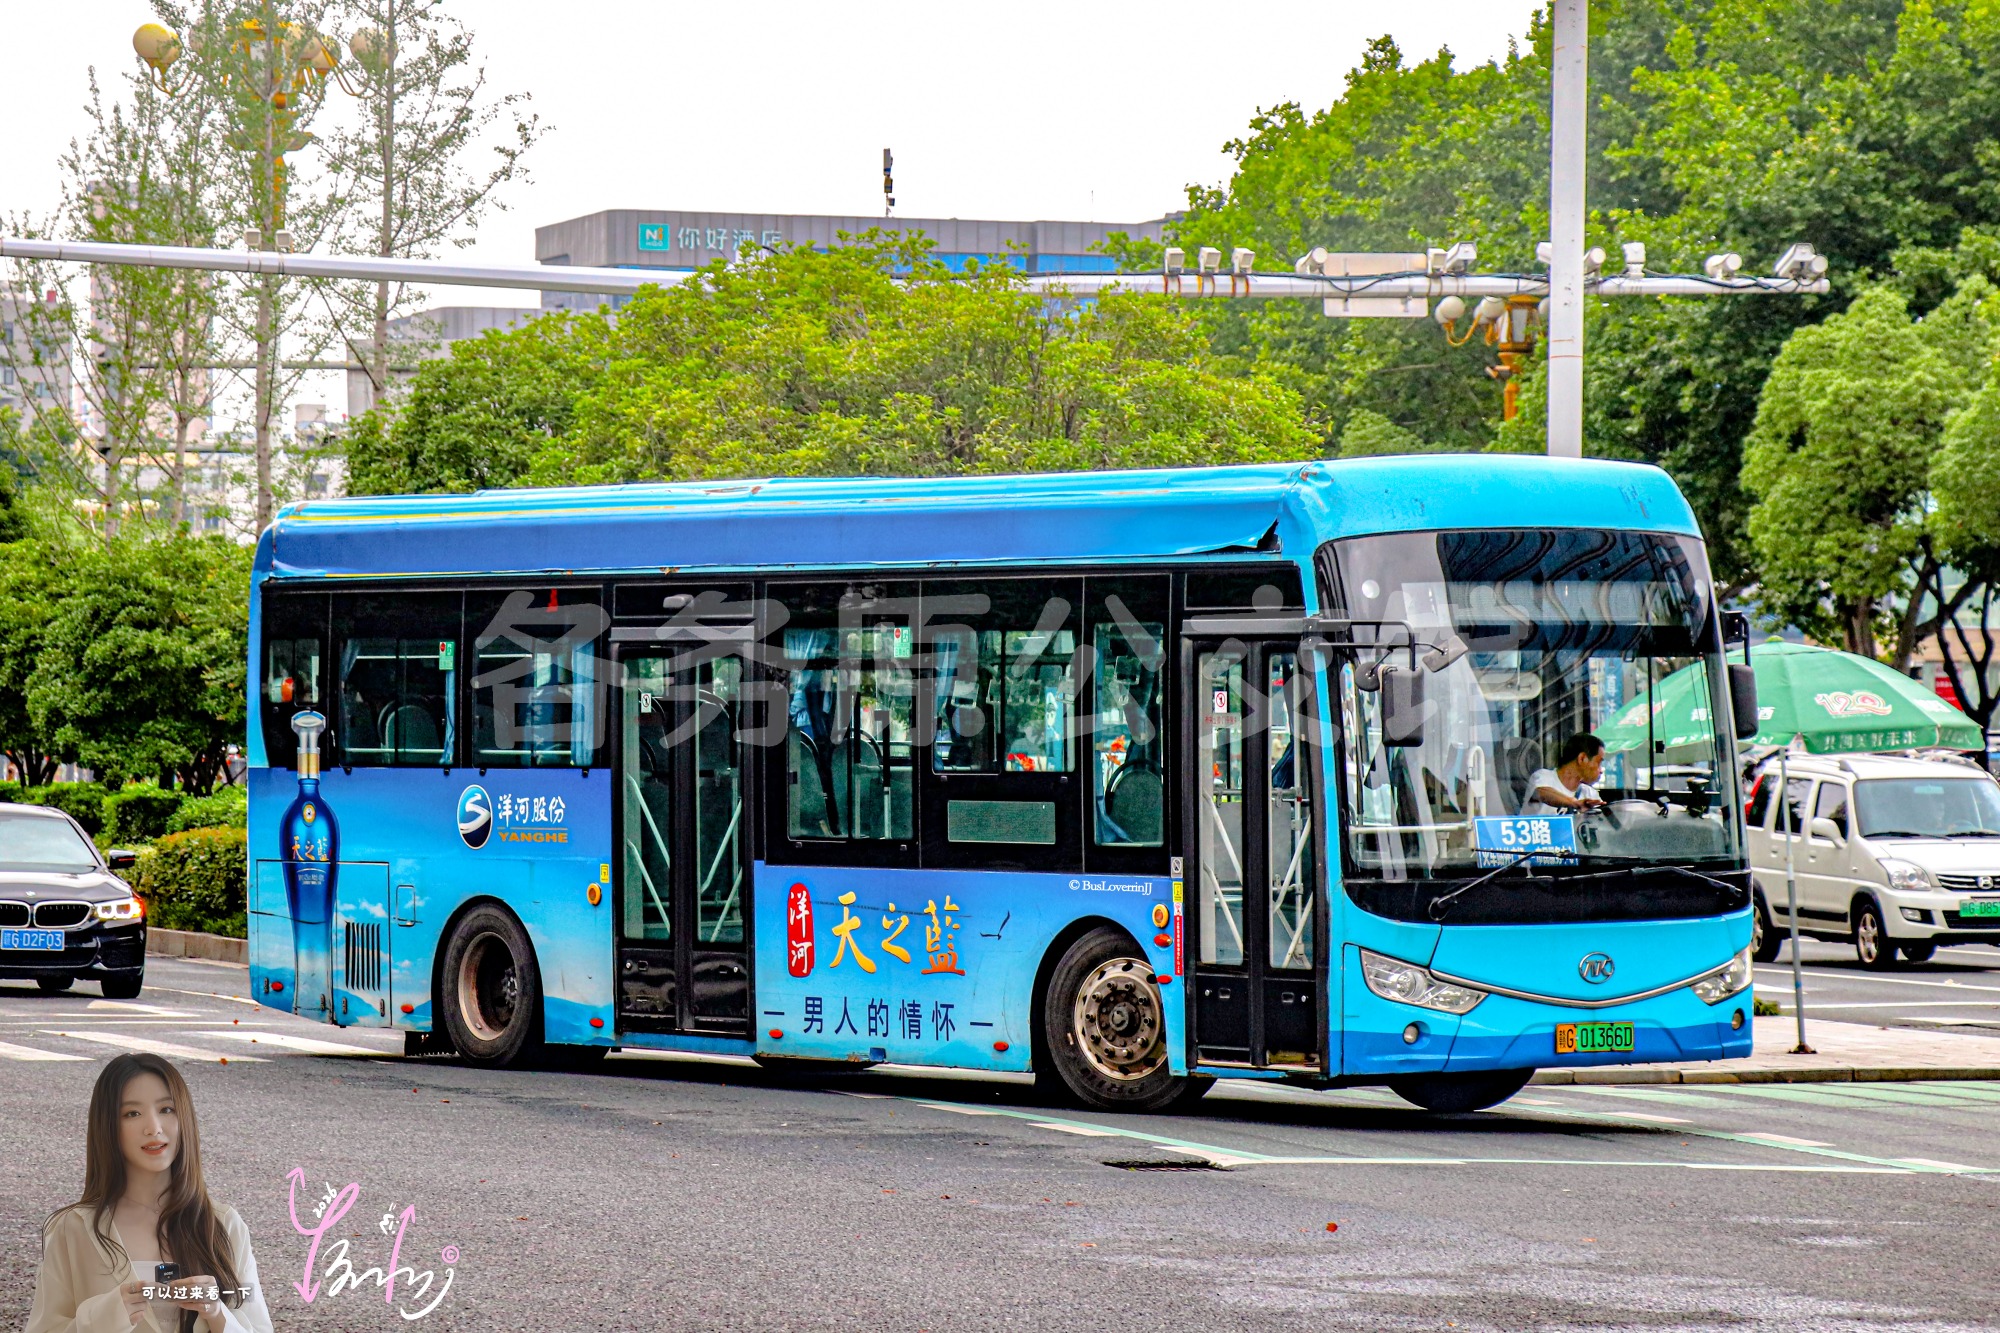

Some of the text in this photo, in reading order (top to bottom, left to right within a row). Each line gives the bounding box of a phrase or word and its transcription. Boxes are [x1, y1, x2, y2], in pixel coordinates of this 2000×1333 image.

[678, 227, 783, 250] 你好酒店
[498, 794, 566, 827] 洋河股份
[498, 832, 568, 843] YANGHE
[1501, 819, 1552, 846] 53路
[790, 891, 813, 974] 洋河
